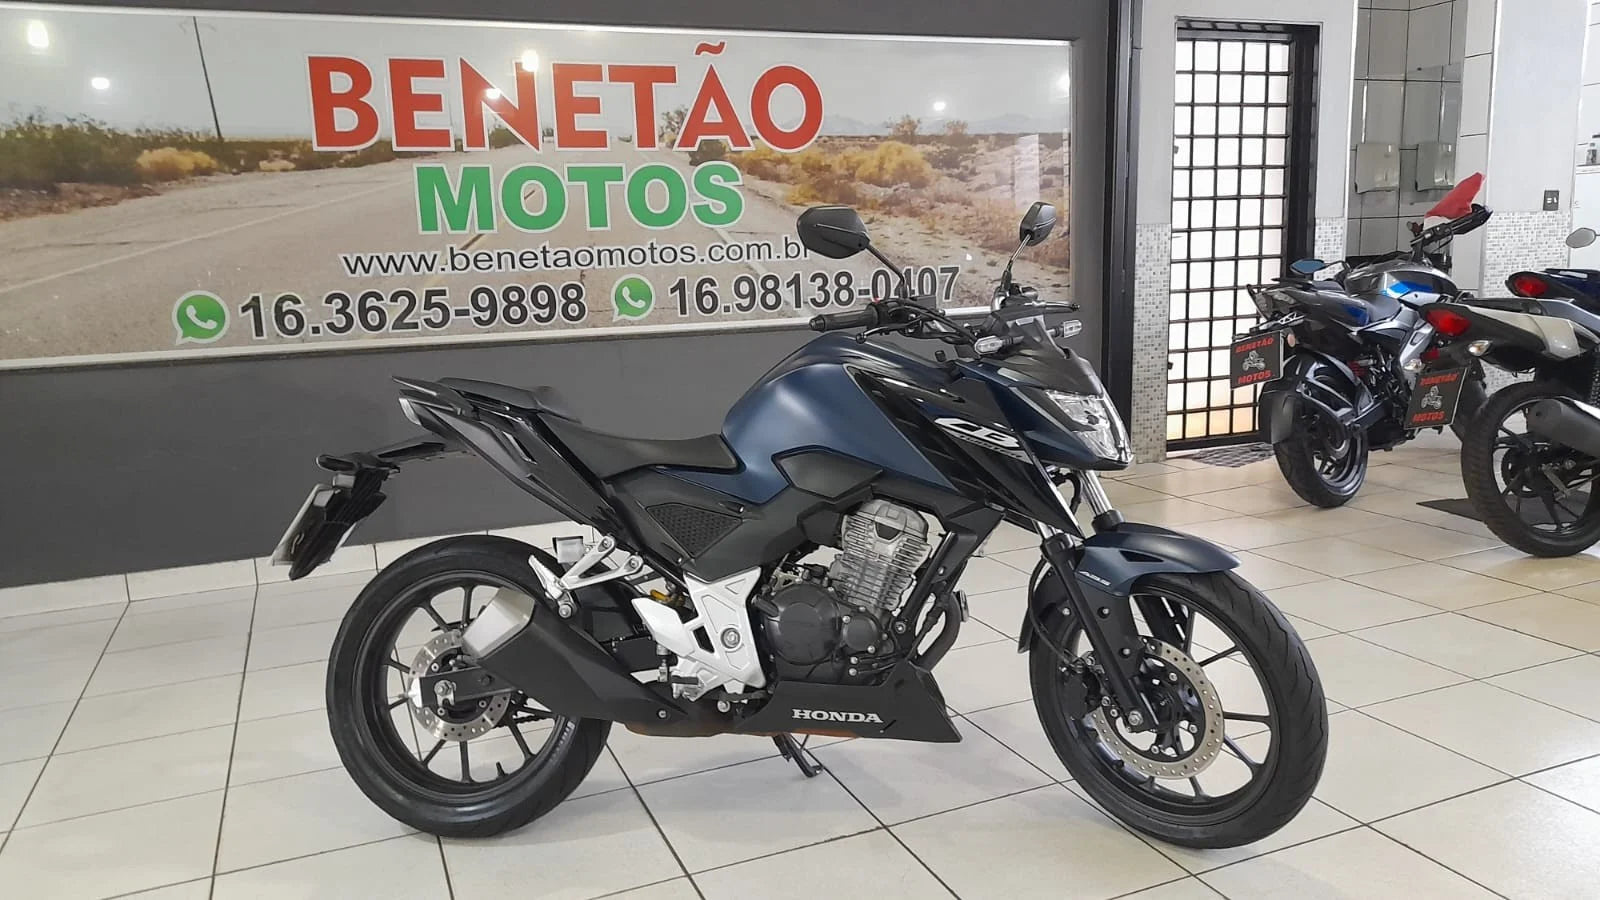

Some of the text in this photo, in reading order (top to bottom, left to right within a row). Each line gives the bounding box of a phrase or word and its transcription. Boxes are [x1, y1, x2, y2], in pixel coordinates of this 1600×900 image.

[308, 42, 823, 150] BENETÃO
[416, 164, 743, 231] MOTOS
[240, 266, 959, 338] 16.3625-9898 16.98138-0407
[1237, 369, 1272, 385] MOTOS
[934, 418, 1020, 447] CB
[791, 708, 884, 723] HONDA
